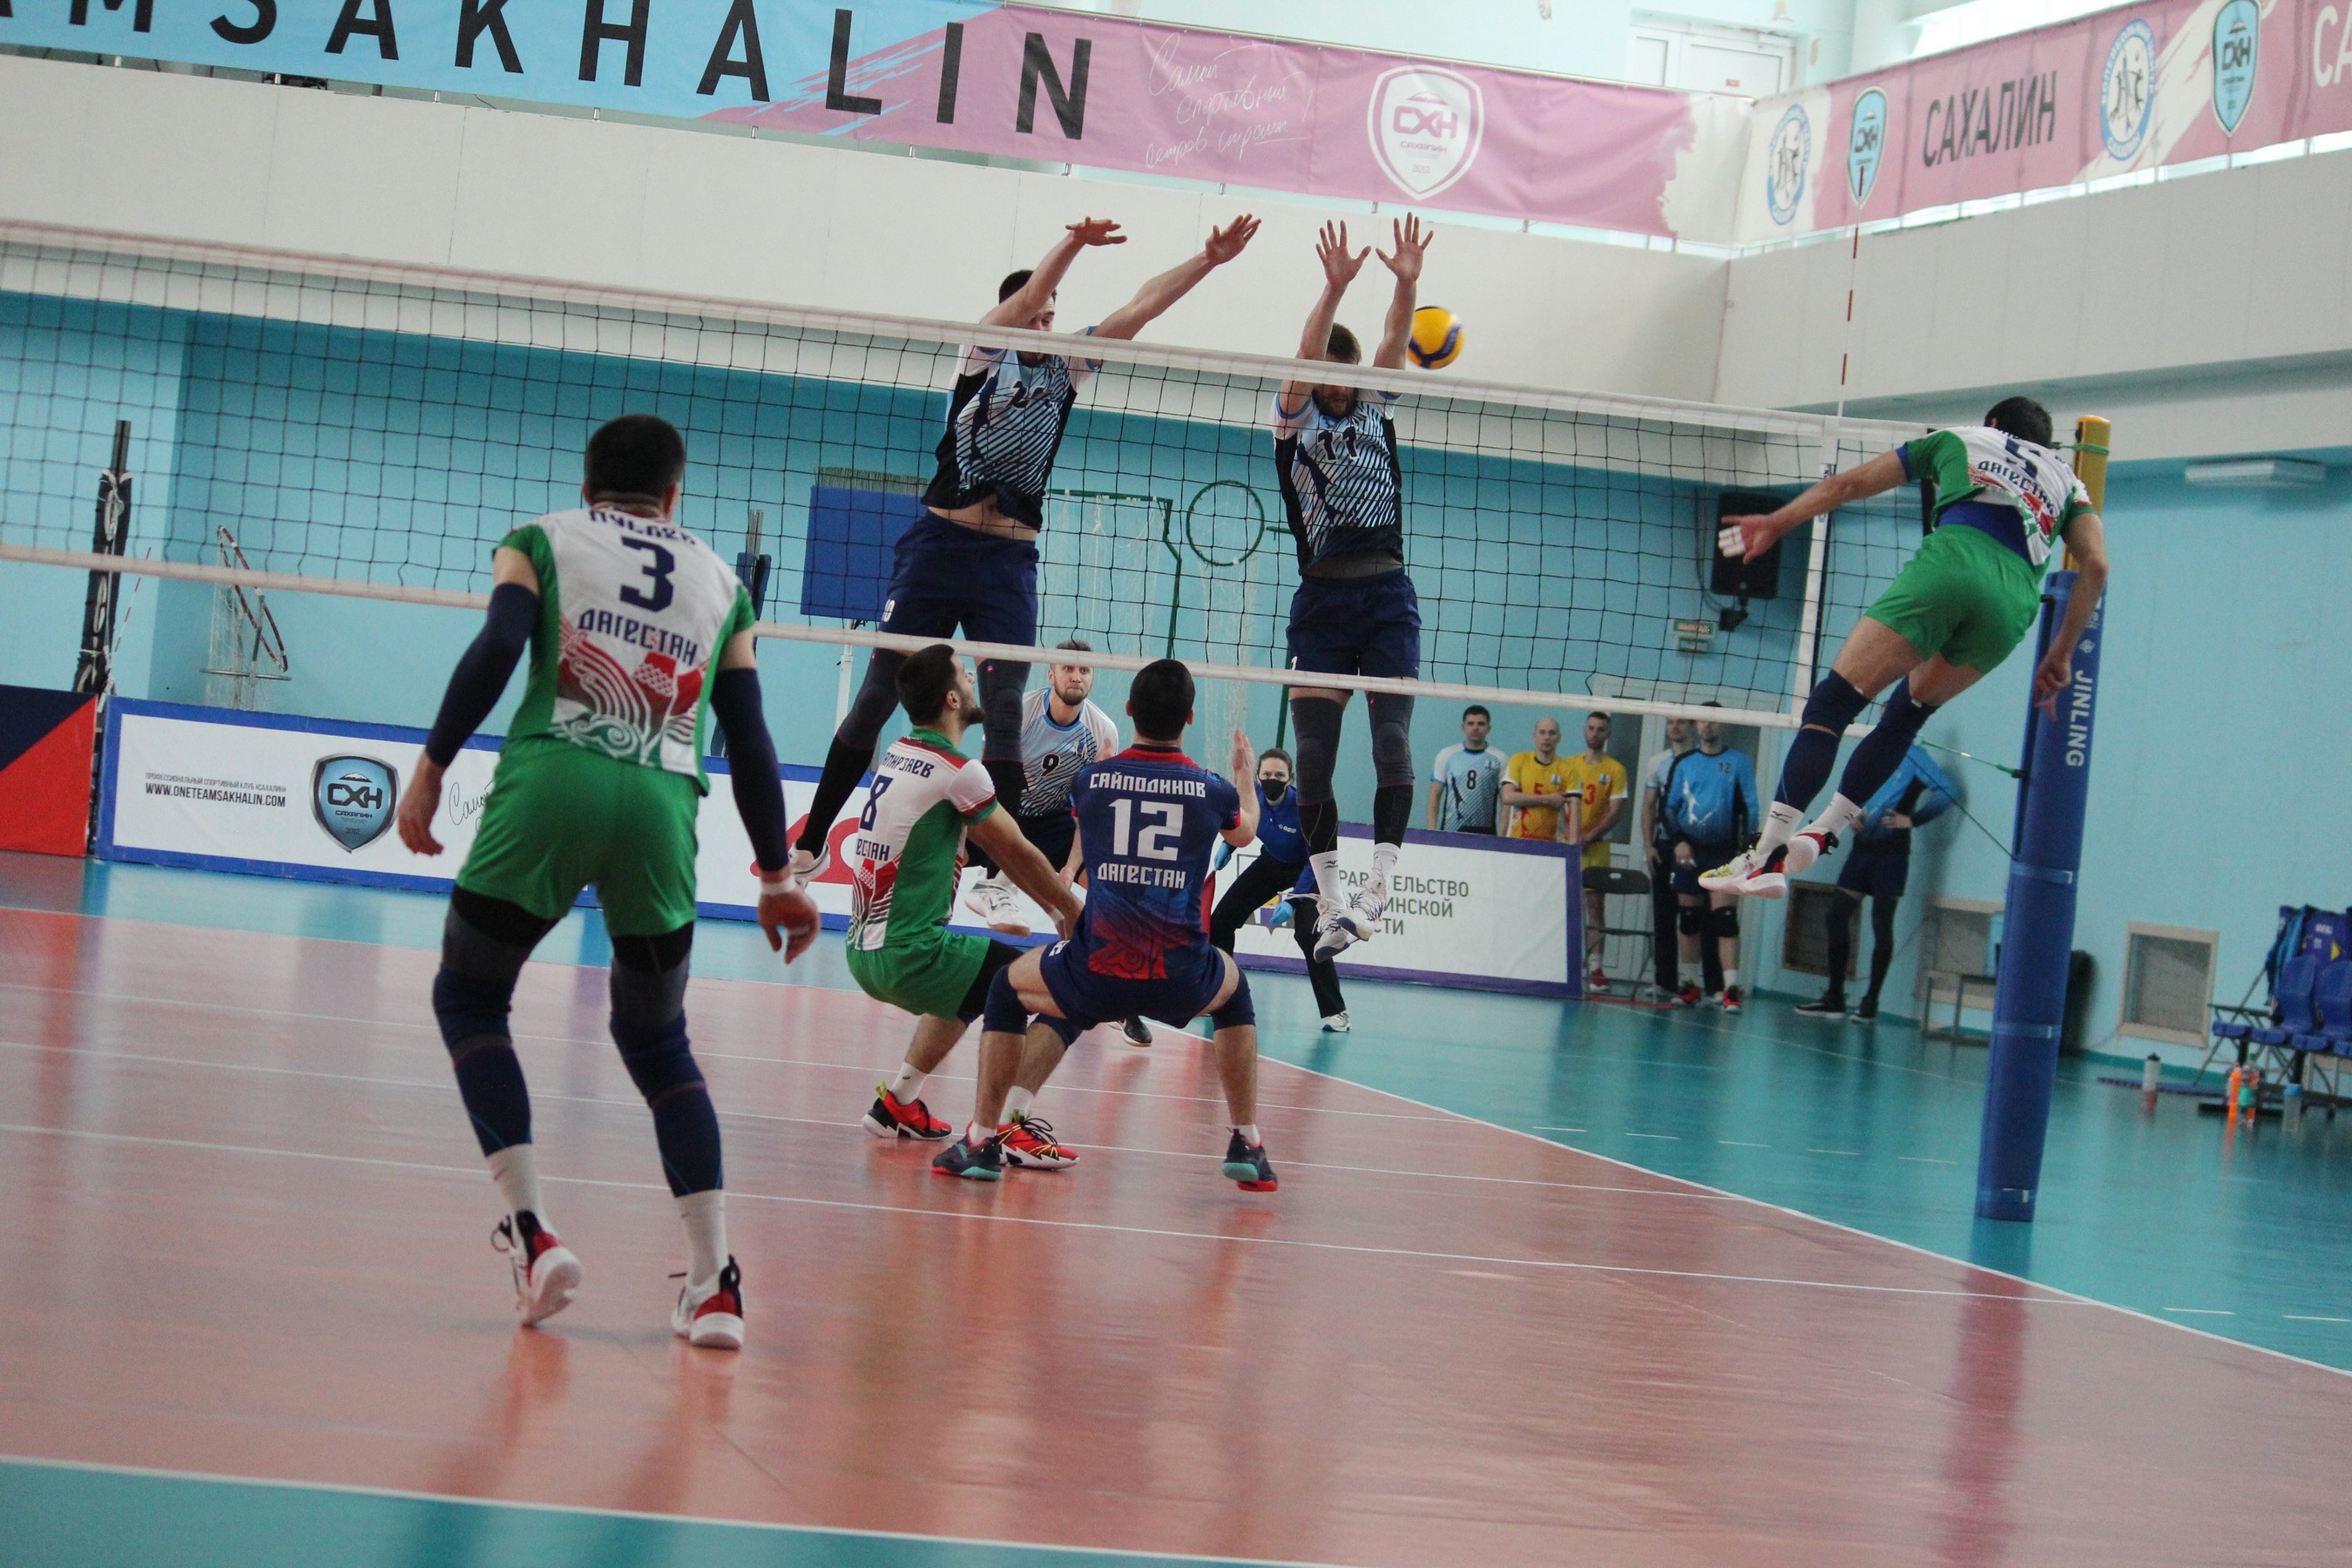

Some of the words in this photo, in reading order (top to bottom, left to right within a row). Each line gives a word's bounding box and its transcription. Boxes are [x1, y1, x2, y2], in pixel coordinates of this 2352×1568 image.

[0, 0, 1091, 139] AKHALIN
[1923, 70, 2057, 167] САХАЛИН
[1318, 426, 1357, 461] 11
[619, 536, 675, 612] 3
[577, 608, 699, 666] ДАГЕСТАН
[2065, 669, 2093, 767] JINLING
[1042, 754, 1059, 776] 9
[1466, 769, 1477, 790] 8
[145, 782, 287, 808] WWW.ONETEAMSAKHALIN.COM
[335, 810, 373, 819] САХАЛИН
[859, 774, 894, 832] 8
[1108, 798, 1185, 862] 12
[1097, 862, 1186, 889] ДАГЕСТАН
[1339, 869, 1470, 897] РАВЕЛЬСТВО
